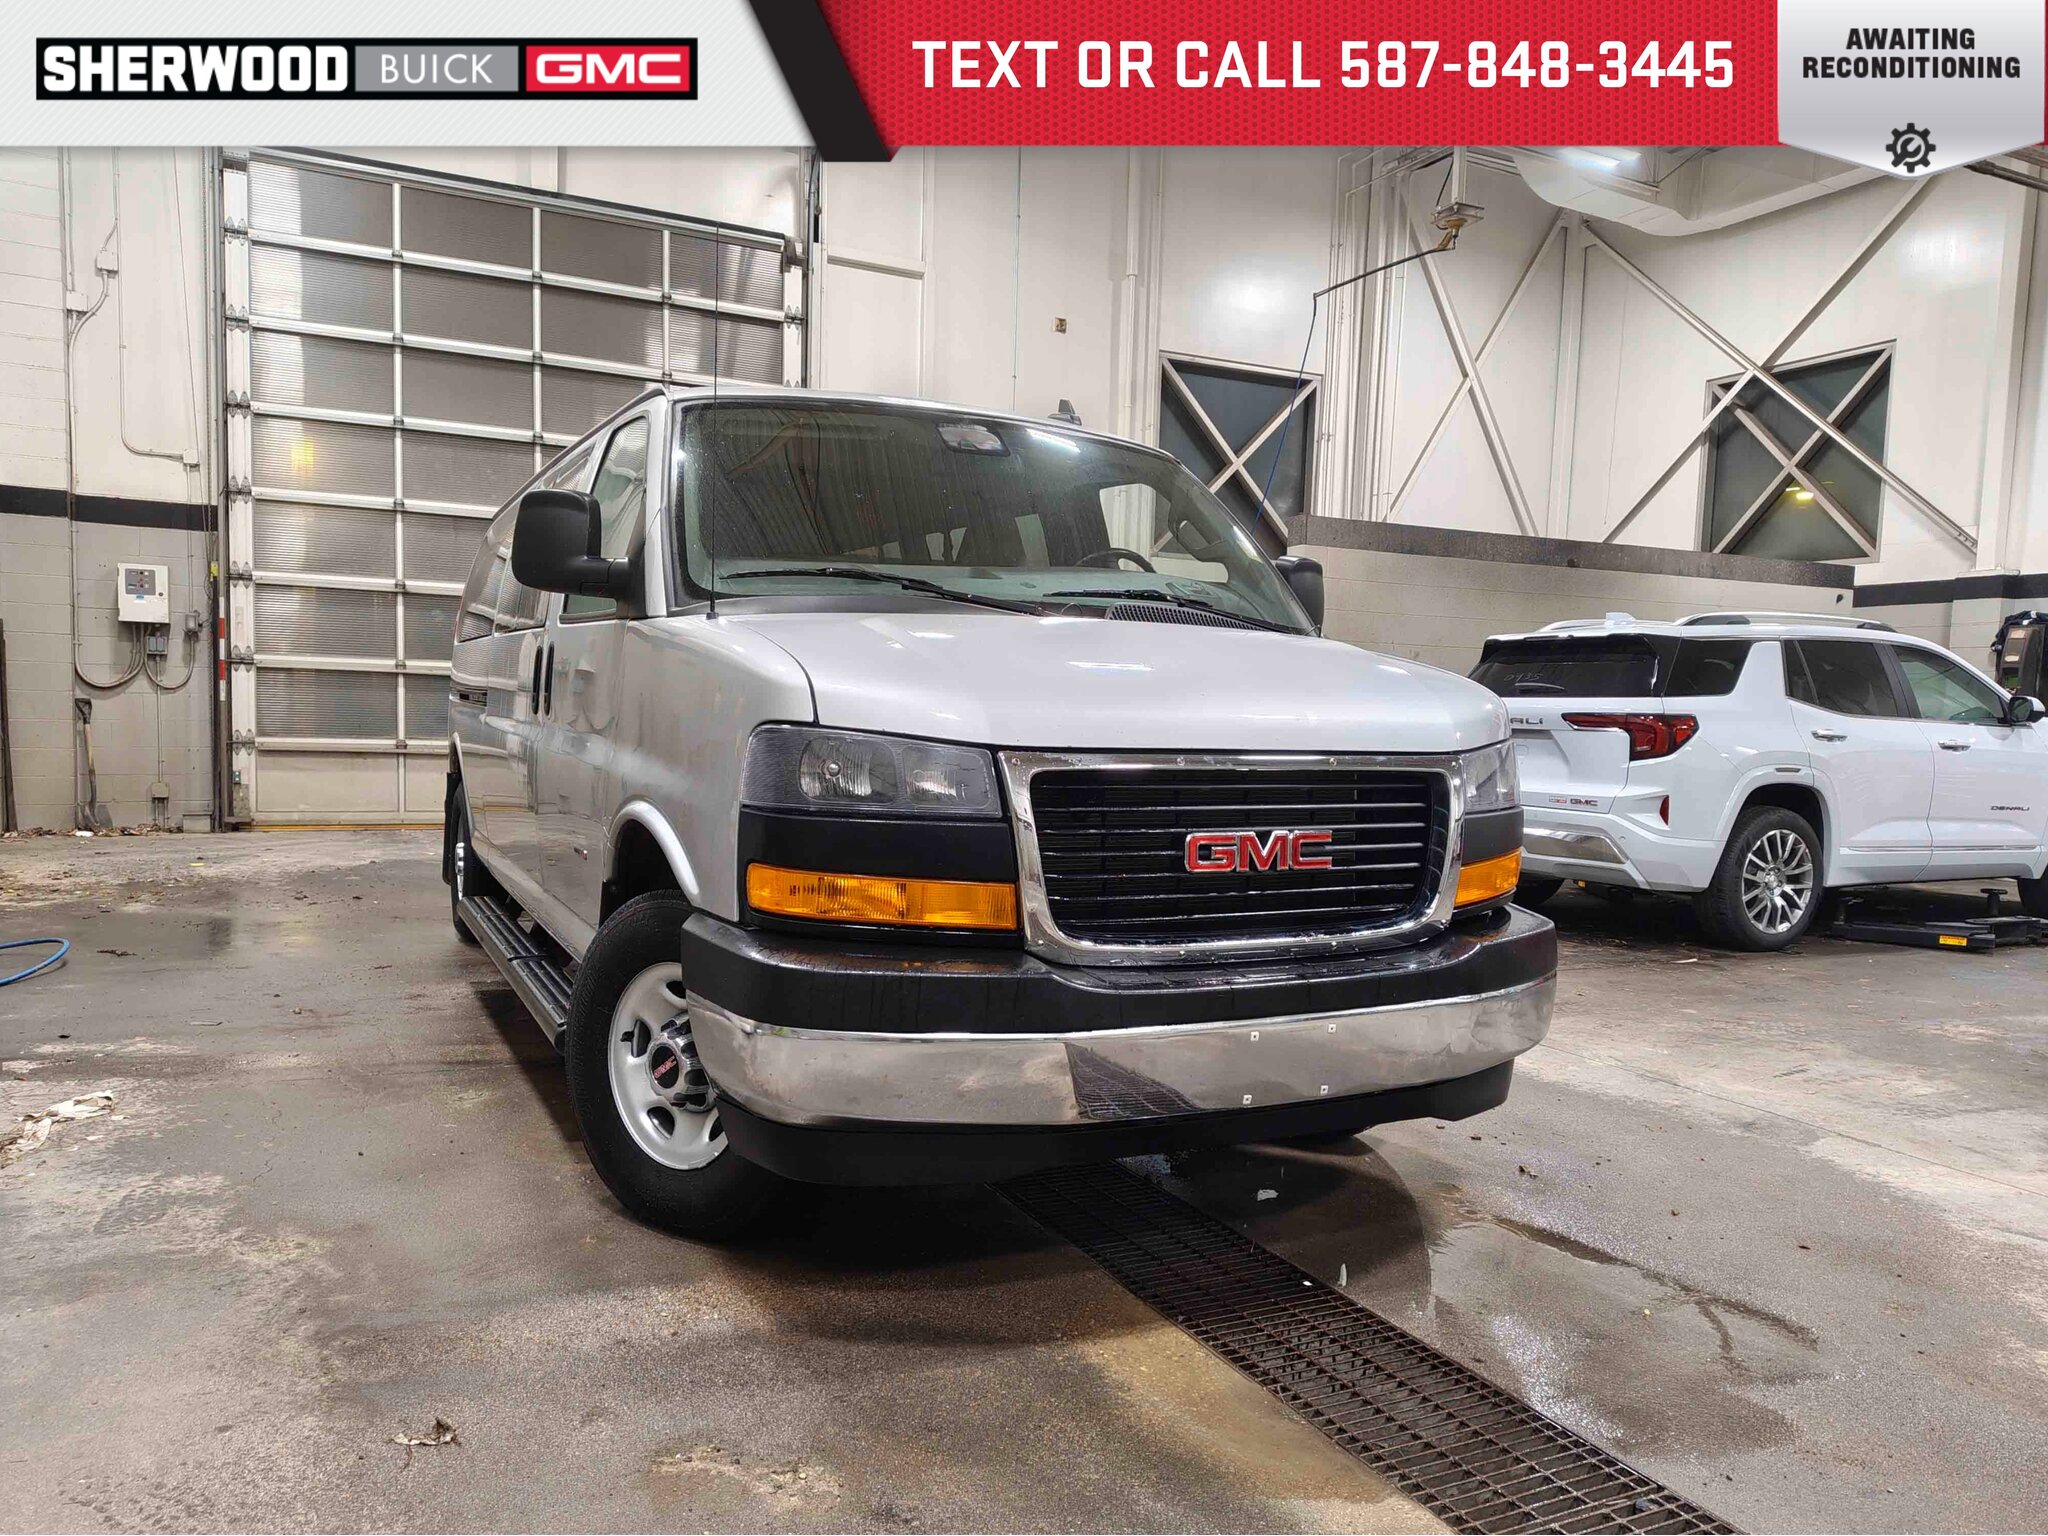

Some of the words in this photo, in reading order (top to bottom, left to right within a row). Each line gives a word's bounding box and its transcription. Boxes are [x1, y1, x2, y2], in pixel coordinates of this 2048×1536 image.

[1510, 717, 1544, 725] ALI
[1570, 798, 1598, 807] GMC
[1185, 830, 1333, 872] GMC
[653, 1055, 677, 1079] GMC
